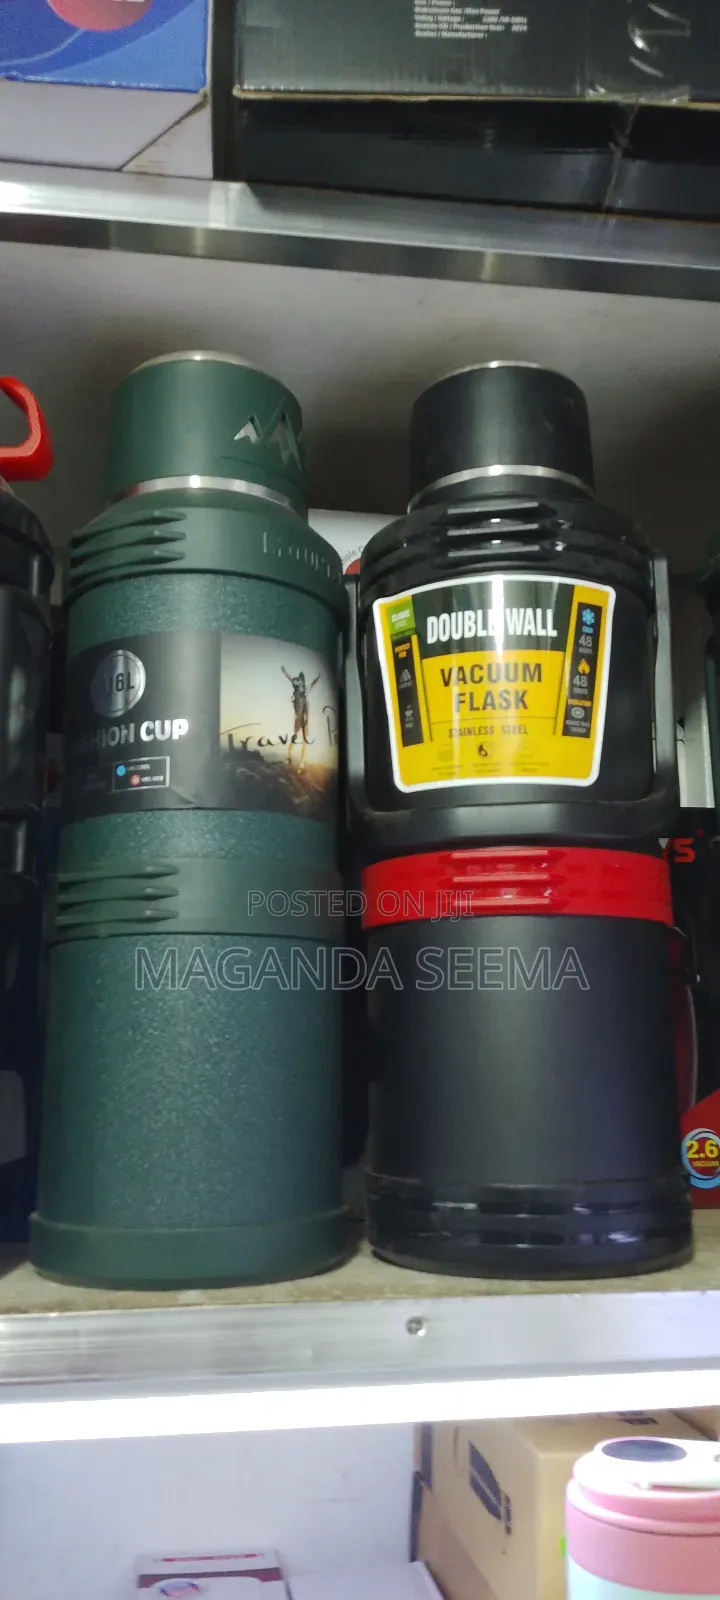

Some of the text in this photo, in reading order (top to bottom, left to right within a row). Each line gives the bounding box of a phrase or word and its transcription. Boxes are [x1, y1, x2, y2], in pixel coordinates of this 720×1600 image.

[505, 607, 558, 638] WALL
[578, 634, 593, 648] 48
[440, 662, 542, 688] VACUUM
[572, 674, 588, 688] 48
[454, 689, 529, 713] FLASK
[139, 718, 189, 743] CUP
[219, 722, 316, 751] Travel
[500, 724, 529, 735] STEEL
[686, 1139, 720, 1159] 2.6
